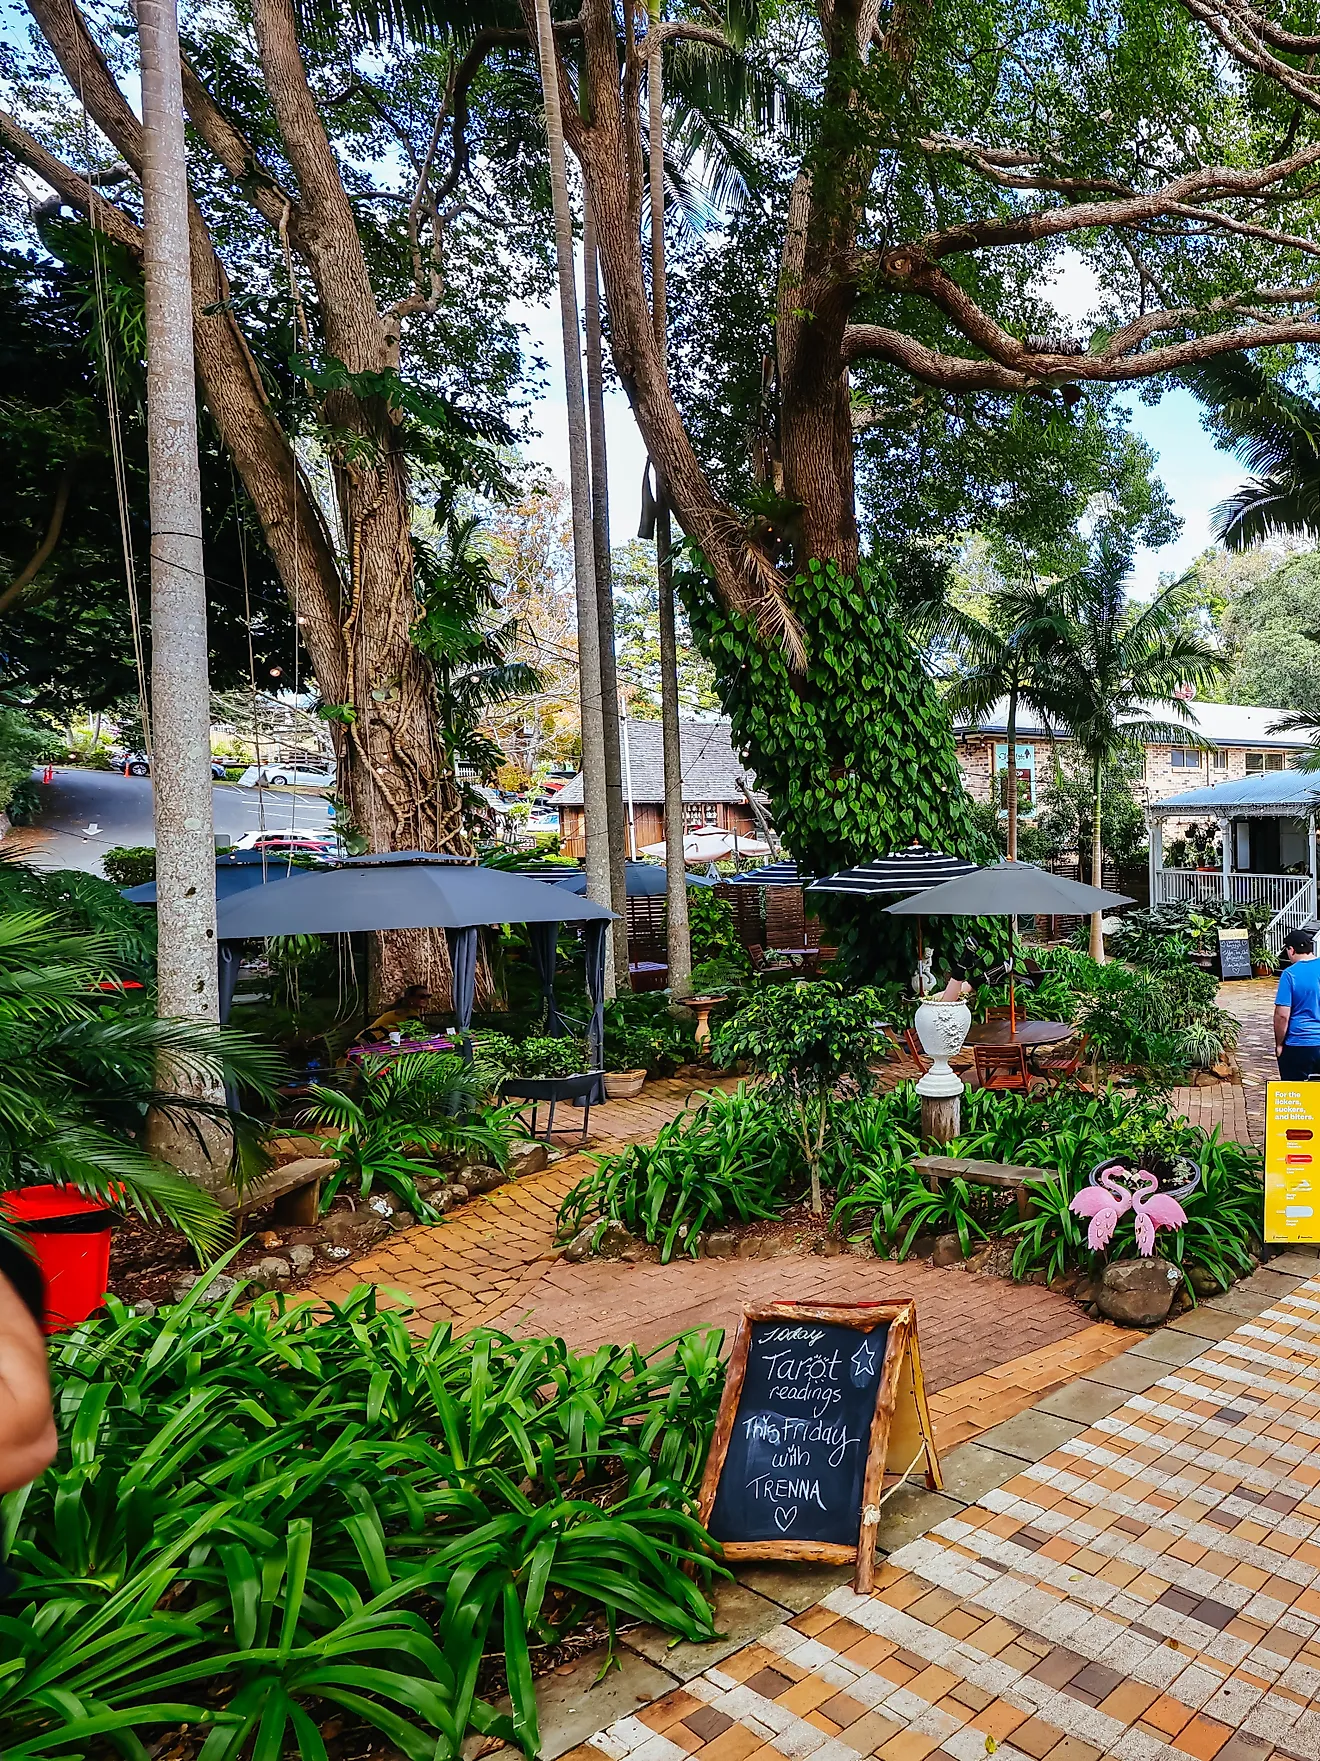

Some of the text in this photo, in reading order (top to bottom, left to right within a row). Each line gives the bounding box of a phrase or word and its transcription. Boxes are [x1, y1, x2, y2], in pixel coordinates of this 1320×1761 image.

[1274, 1106, 1306, 1114] suckers,
[758, 1327, 827, 1347] Today
[762, 1349, 843, 1380] Tarot
[769, 1384, 842, 1418] readings
[742, 1415, 860, 1467] This Friday
[772, 1443, 811, 1469] with
[746, 1473, 827, 1511] TRENNA
